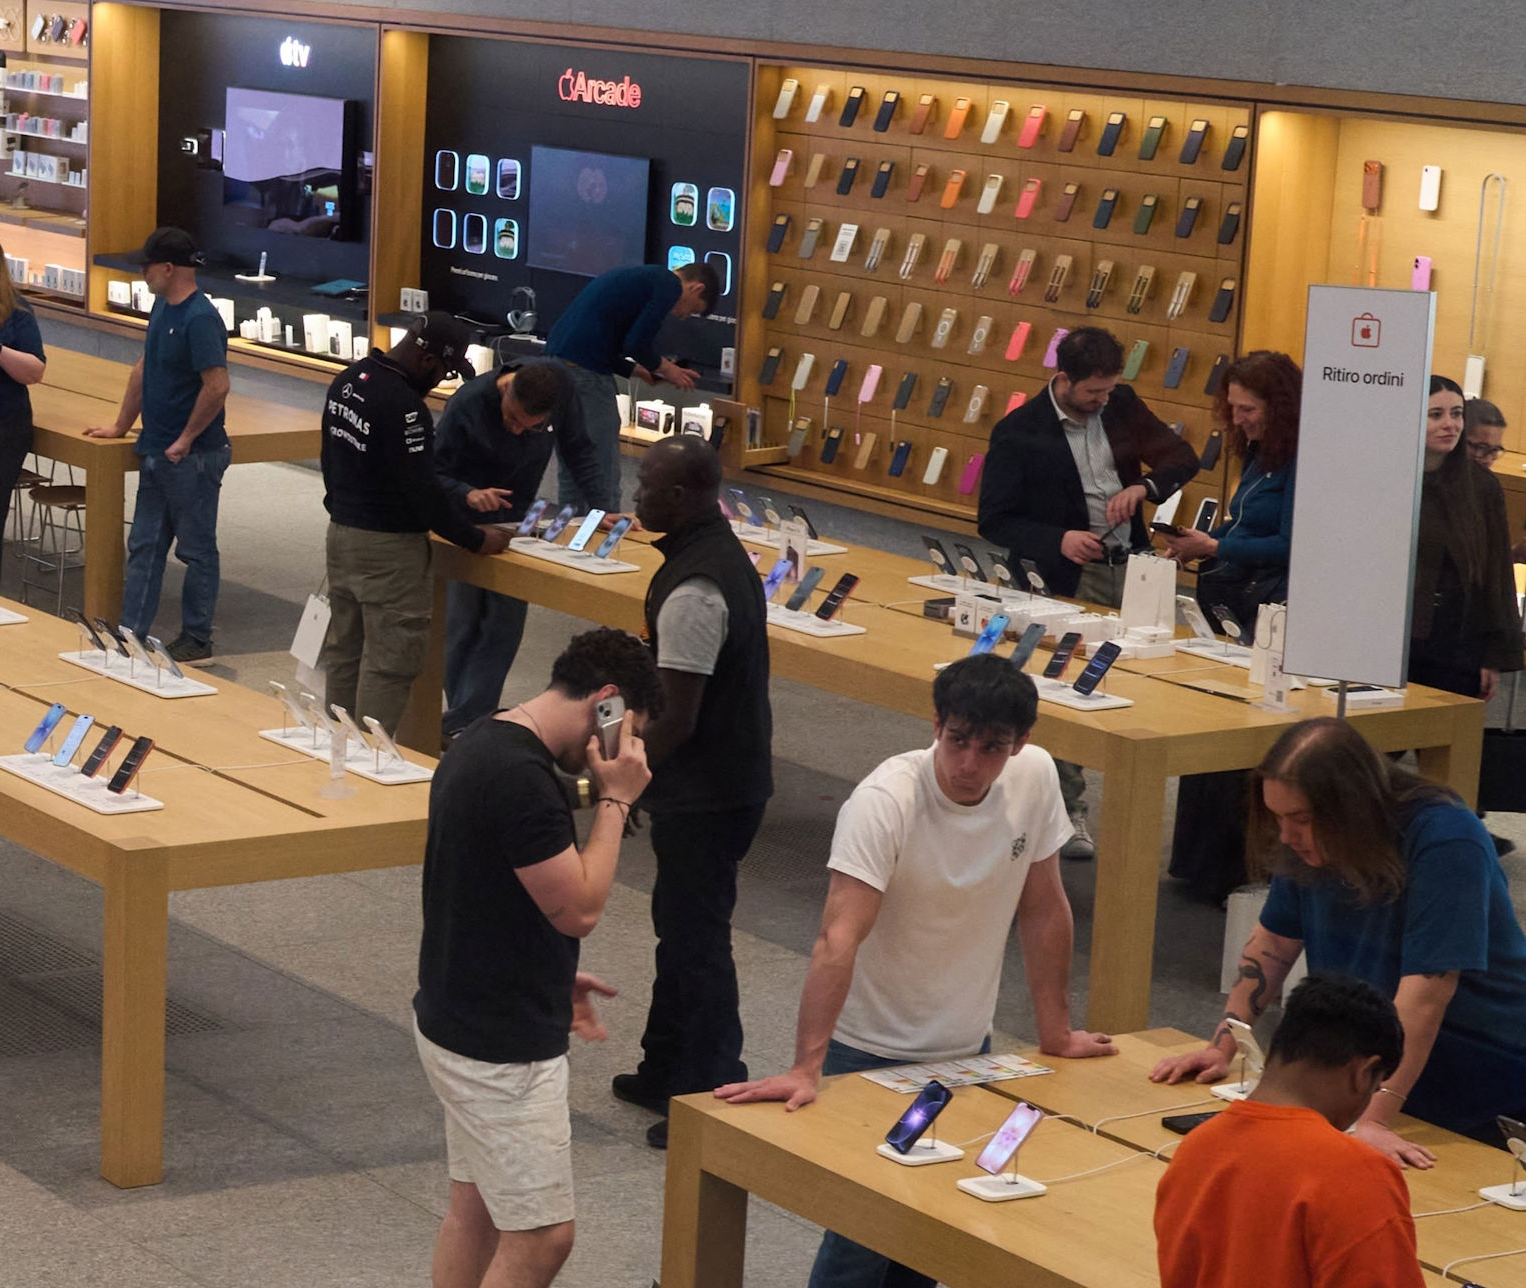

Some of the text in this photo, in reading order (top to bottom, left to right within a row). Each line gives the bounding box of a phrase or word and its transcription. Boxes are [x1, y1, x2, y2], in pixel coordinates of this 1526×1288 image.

[573, 71, 642, 108] Arcade
[1322, 366, 1405, 388] Ritiro ordini
[328, 399, 371, 436] PETRONAS
